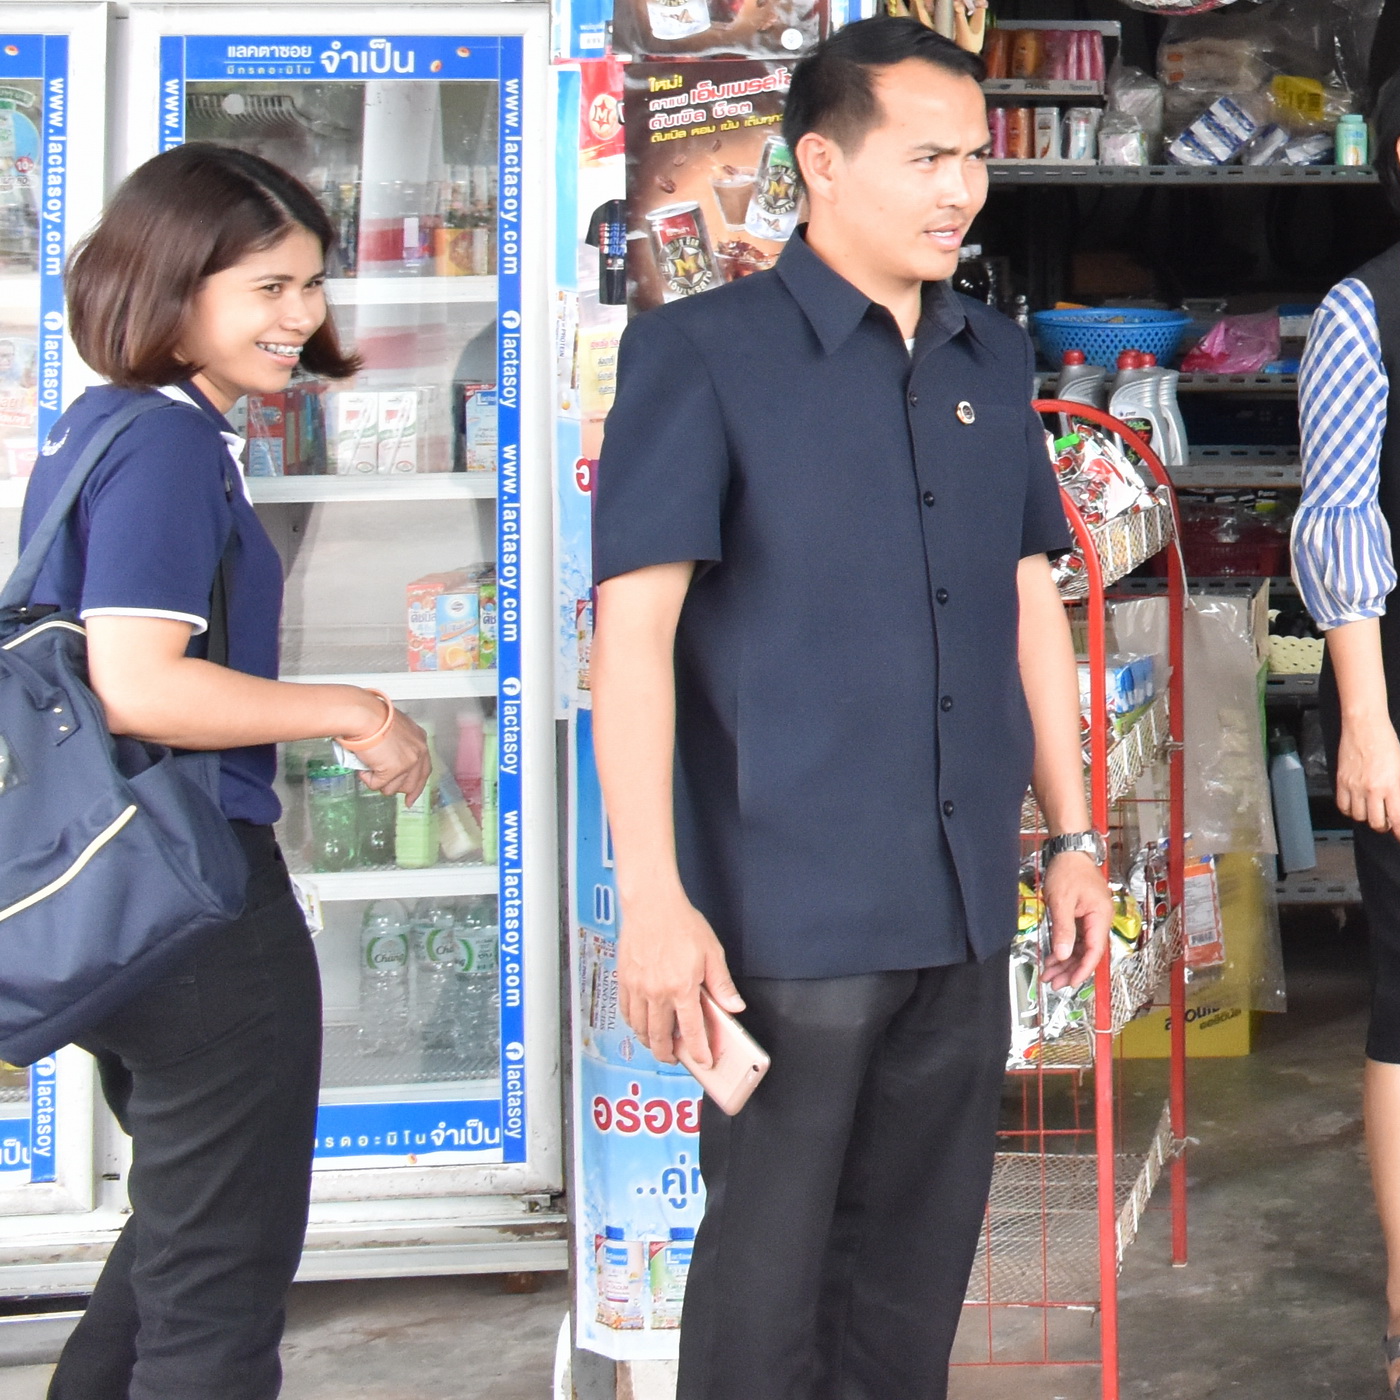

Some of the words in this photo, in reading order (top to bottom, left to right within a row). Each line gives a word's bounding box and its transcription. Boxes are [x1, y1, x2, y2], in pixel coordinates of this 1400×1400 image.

[227, 44, 312, 59] แลคตาซอย
[320, 37, 415, 74] จำเป็น
[43, 78, 67, 276] www.lactasoy.com
[498, 78, 521, 276] www.lactasoy.com
[40, 335, 62, 411] lactasoy
[500, 332, 521, 407] lactasoy
[500, 444, 521, 643] www.lactasoy.com
[501, 698, 522, 774] lactasoy
[502, 809, 523, 1008] www.lactasoy.com
[33, 1080, 56, 1157] lactasoy
[430, 1118, 499, 1149] จำเป็น
[505, 1063, 526, 1139] lactasoy
